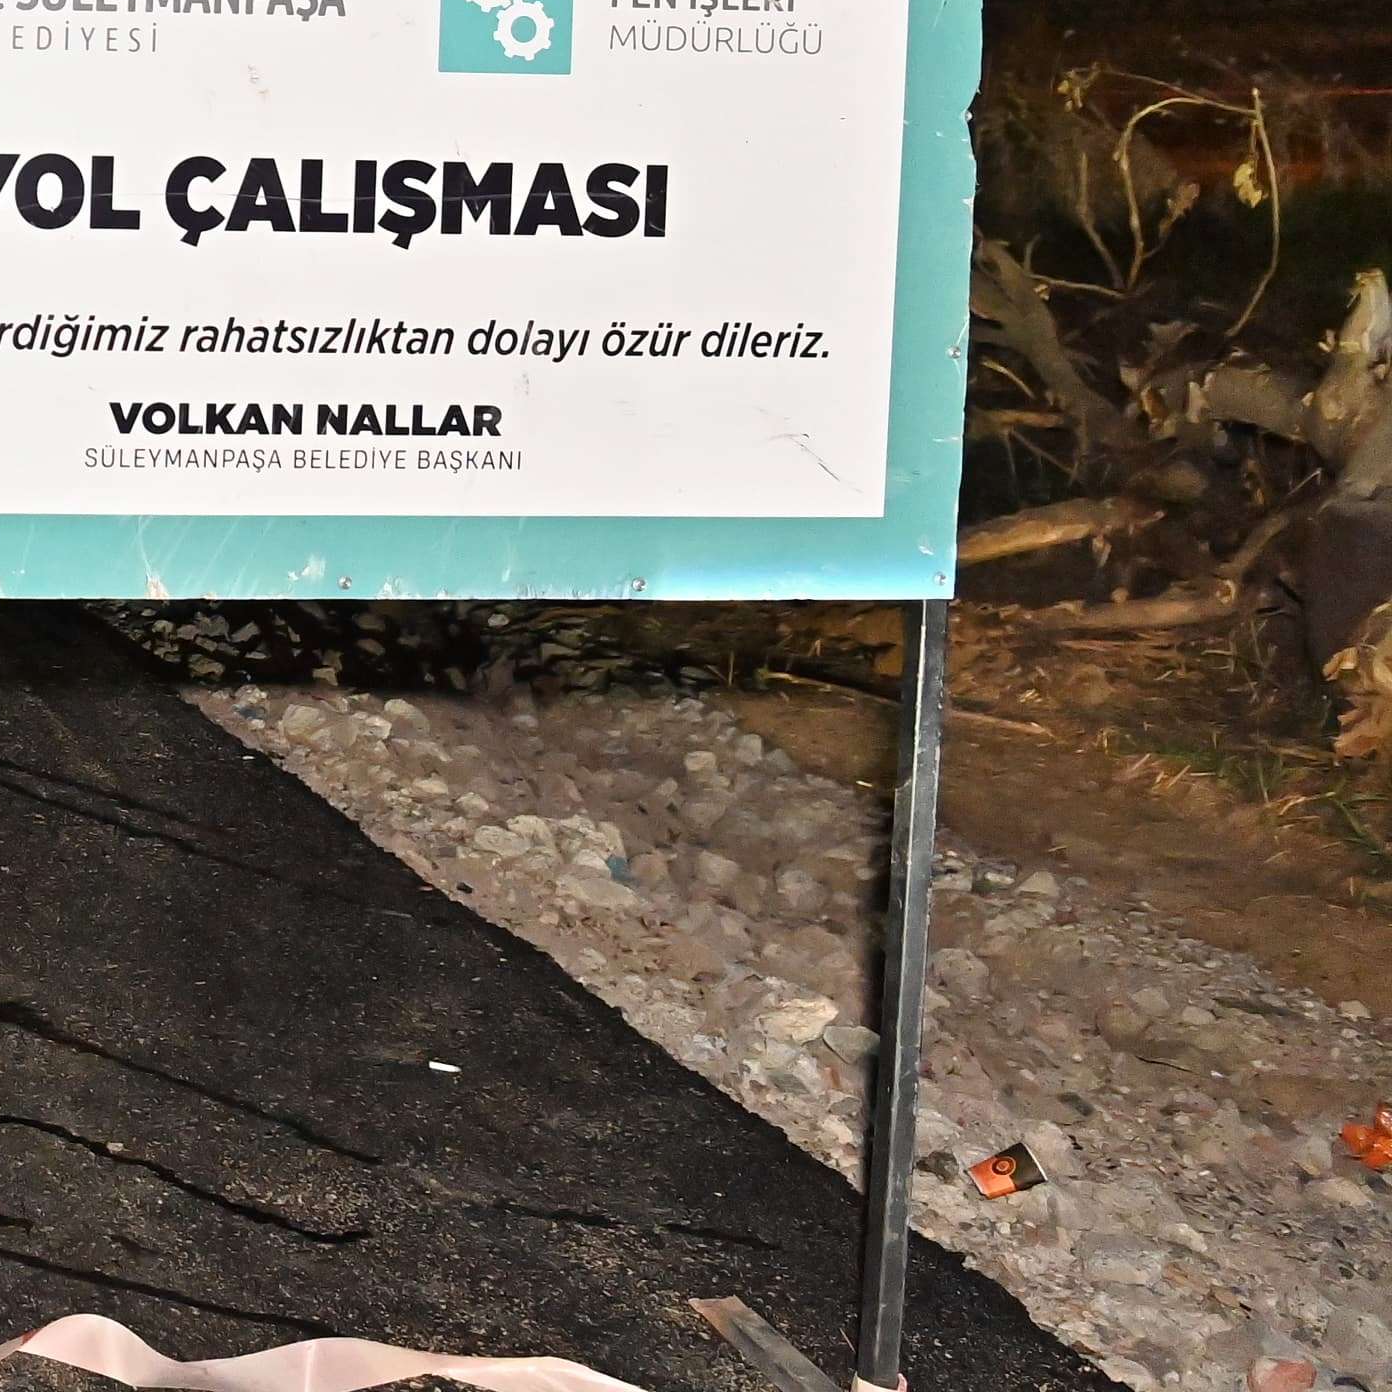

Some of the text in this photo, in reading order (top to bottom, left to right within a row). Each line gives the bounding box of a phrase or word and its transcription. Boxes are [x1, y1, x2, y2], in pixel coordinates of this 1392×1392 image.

[610, 19, 823, 55] MÜDÜRLÜĞÜ
[165, 154, 669, 250] ÇALIŞMASI
[179, 316, 455, 356] rahatsızlıktan
[468, 320, 591, 363] dolayı
[602, 322, 693, 358] özür
[701, 322, 830, 359] dileriz.
[109, 402, 503, 437] VOLKAN NALLAR
[84, 445, 522, 475] SÜLEYMANPAŞA BELEDİYE BAŞKANI
